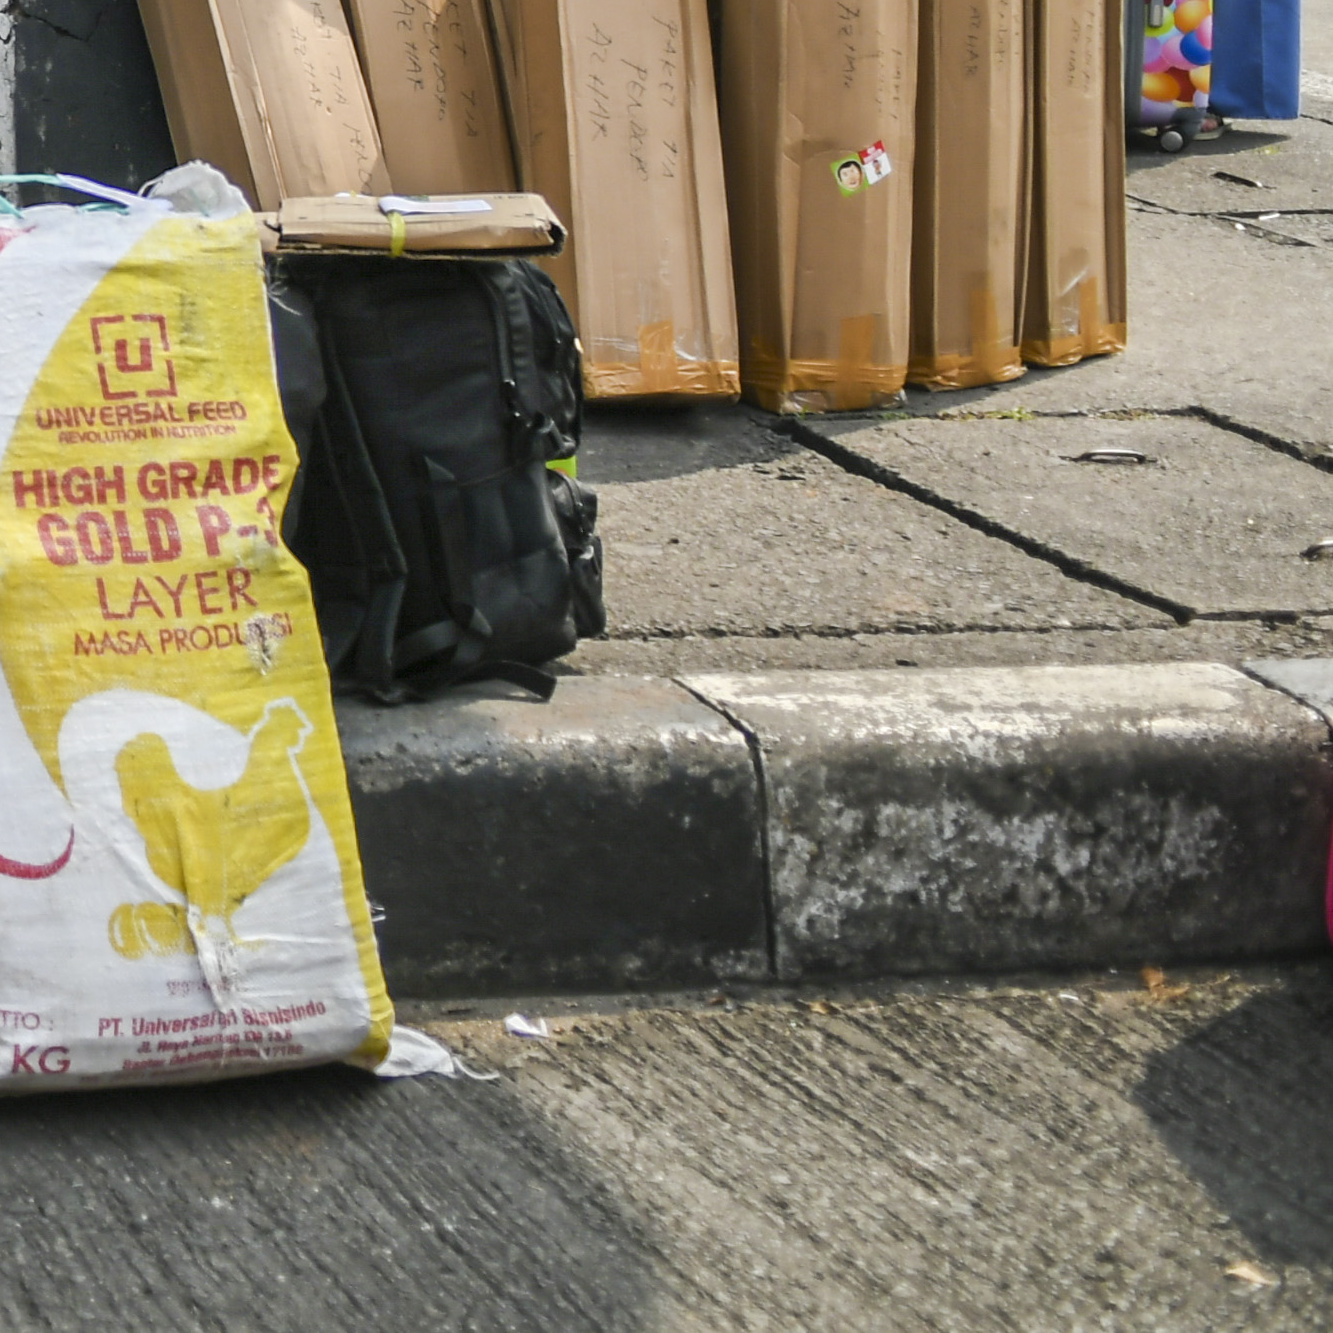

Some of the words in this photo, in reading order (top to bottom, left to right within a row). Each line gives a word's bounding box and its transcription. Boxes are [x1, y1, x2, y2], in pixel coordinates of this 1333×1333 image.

[35, 401, 184, 430] UNIVERSAL
[188, 401, 247, 422] FEED
[58, 428, 147, 445] REVOLUTION
[150, 426, 164, 439] IN
[167, 424, 237, 438] NUTRITION
[12, 465, 128, 509] HIGH
[137, 454, 282, 503] GRADE
[36, 507, 184, 567] GOLD
[96, 566, 259, 620] LAYER
[74, 629, 154, 657] MASA
[98, 1017, 125, 1038] PT.
[12, 1043, 72, 1074] KG
